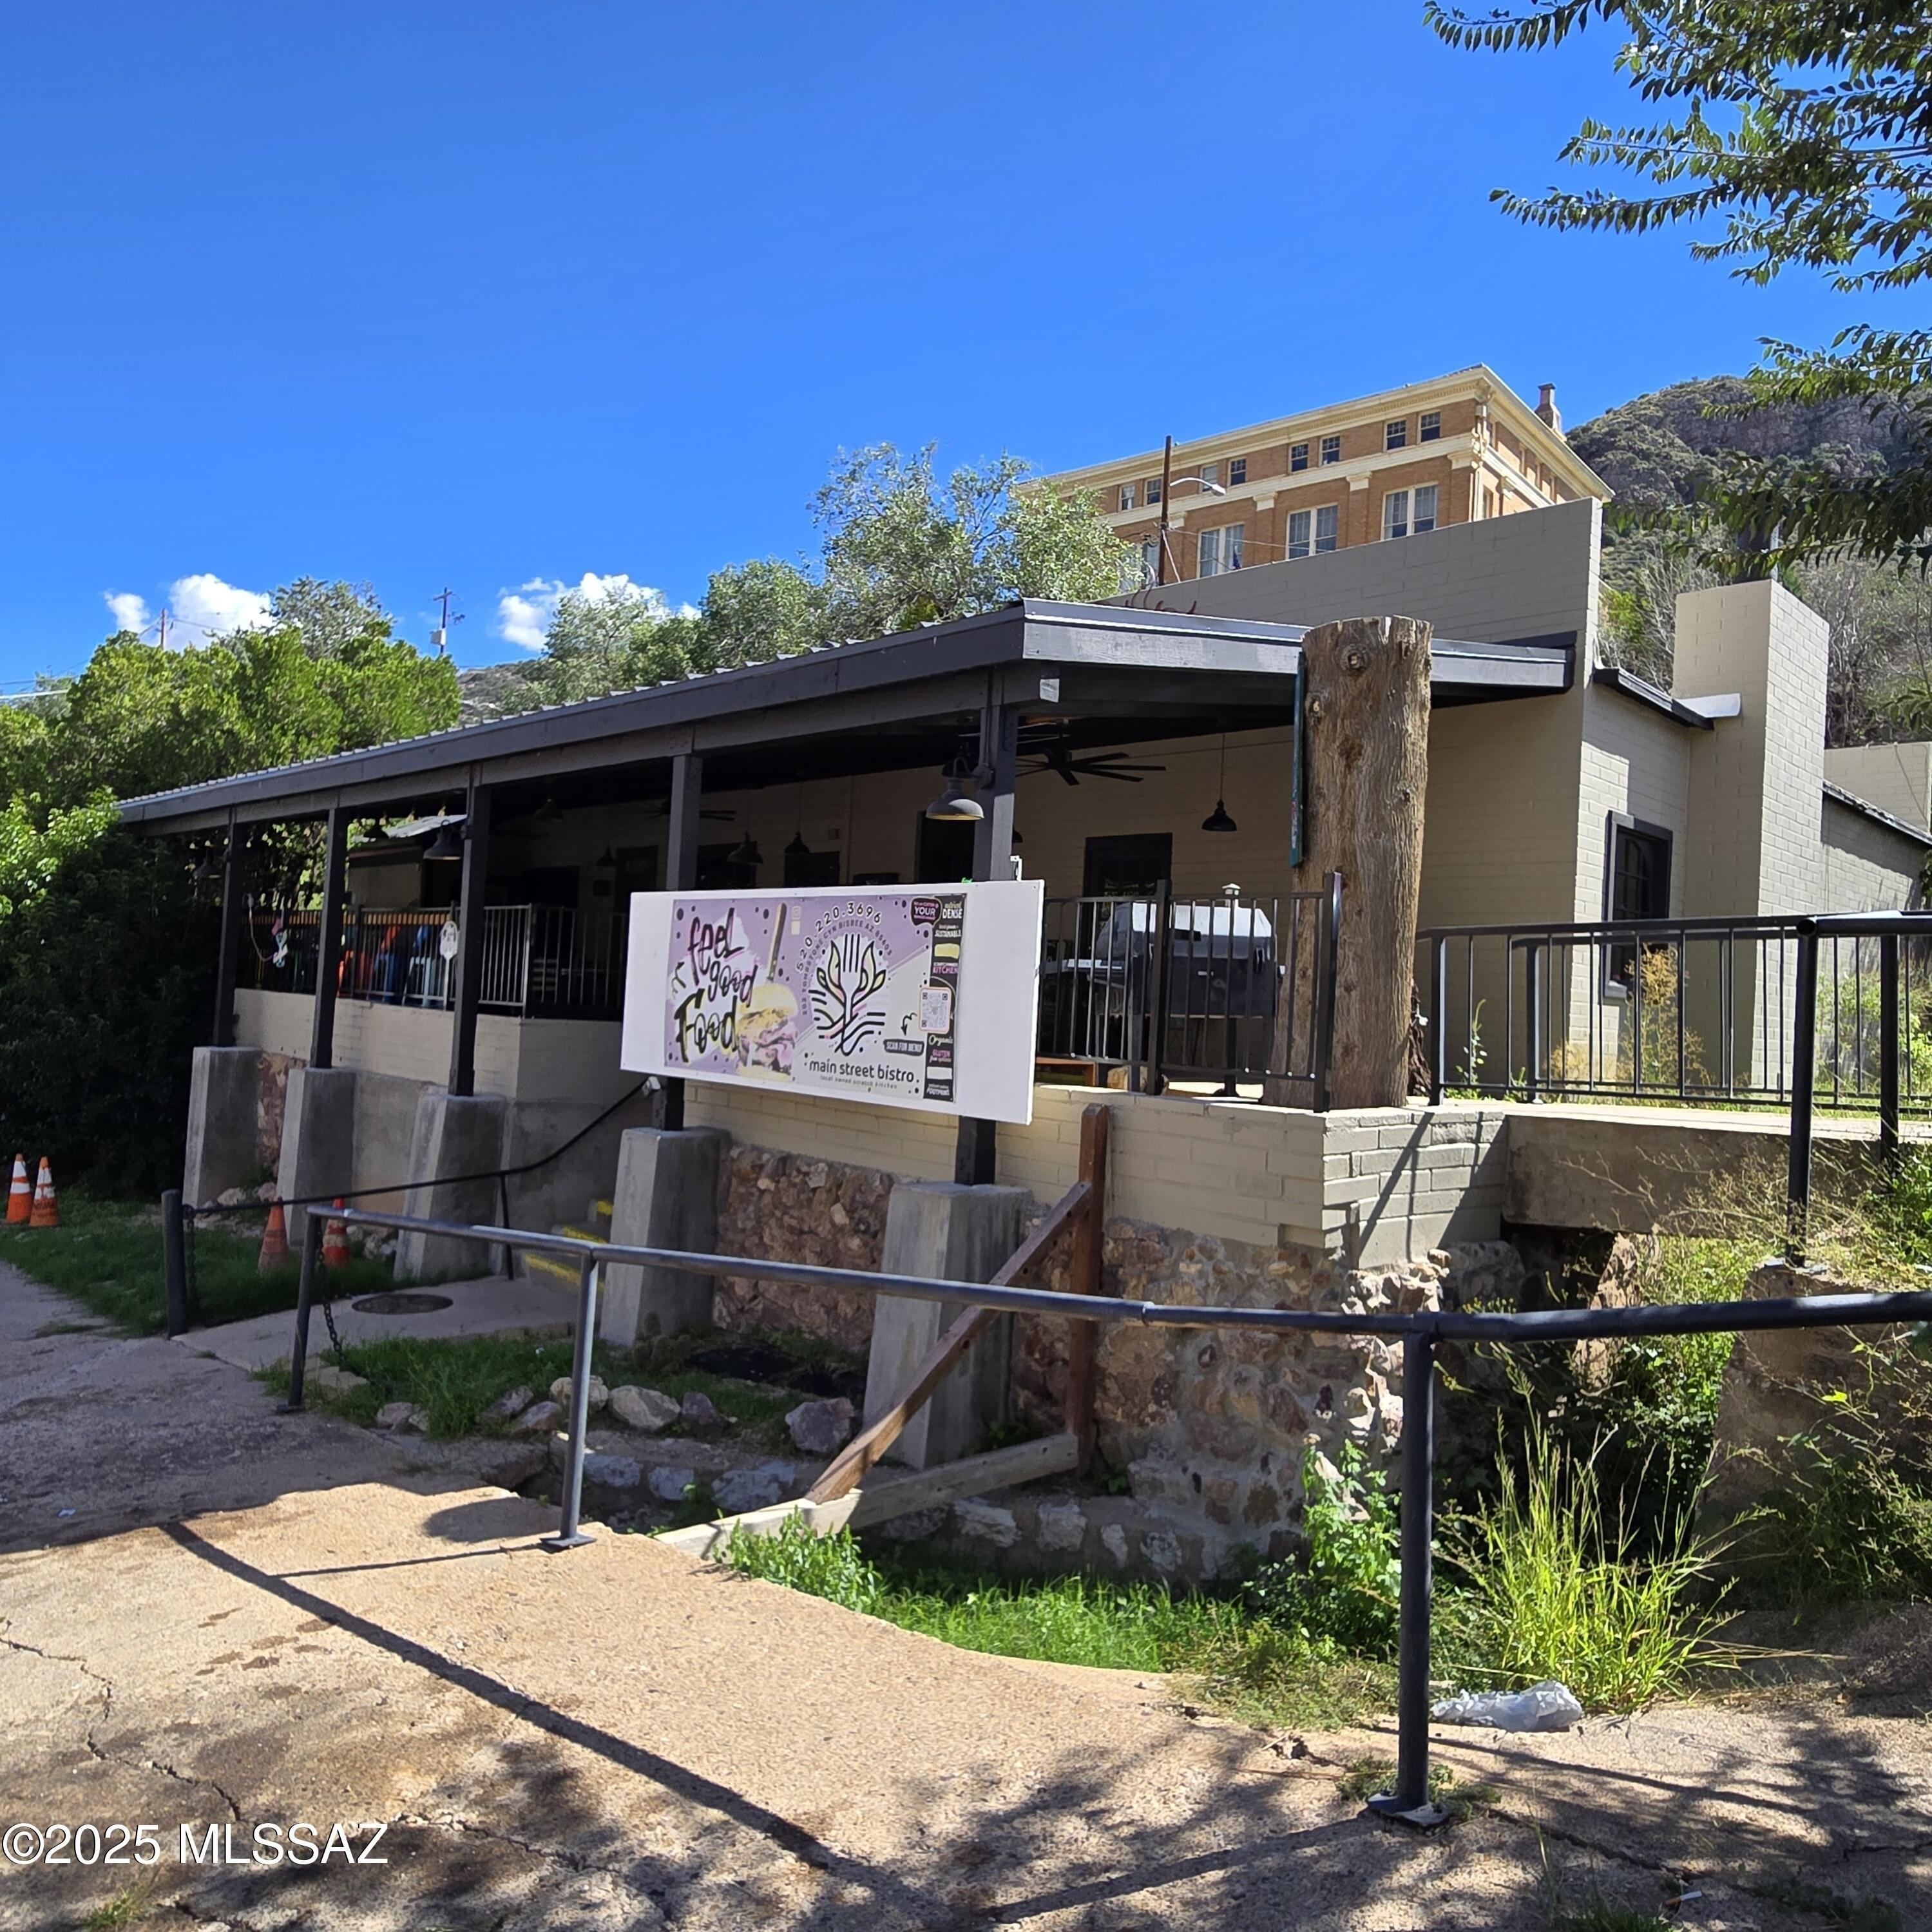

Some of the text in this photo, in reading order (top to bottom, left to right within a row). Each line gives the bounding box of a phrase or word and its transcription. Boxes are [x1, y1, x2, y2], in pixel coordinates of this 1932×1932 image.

[914, 906, 936, 916] YOUR
[942, 908, 962, 919] DENSE
[687, 908, 745, 986] feel
[801, 939, 823, 993] TOMBSTONE
[839, 919, 864, 927] BISBEE
[865, 923, 874, 933] AZ
[708, 961, 758, 1008] good
[674, 988, 739, 1063] Food
[809, 1058, 837, 1074] main
[839, 1062, 874, 1078] street
